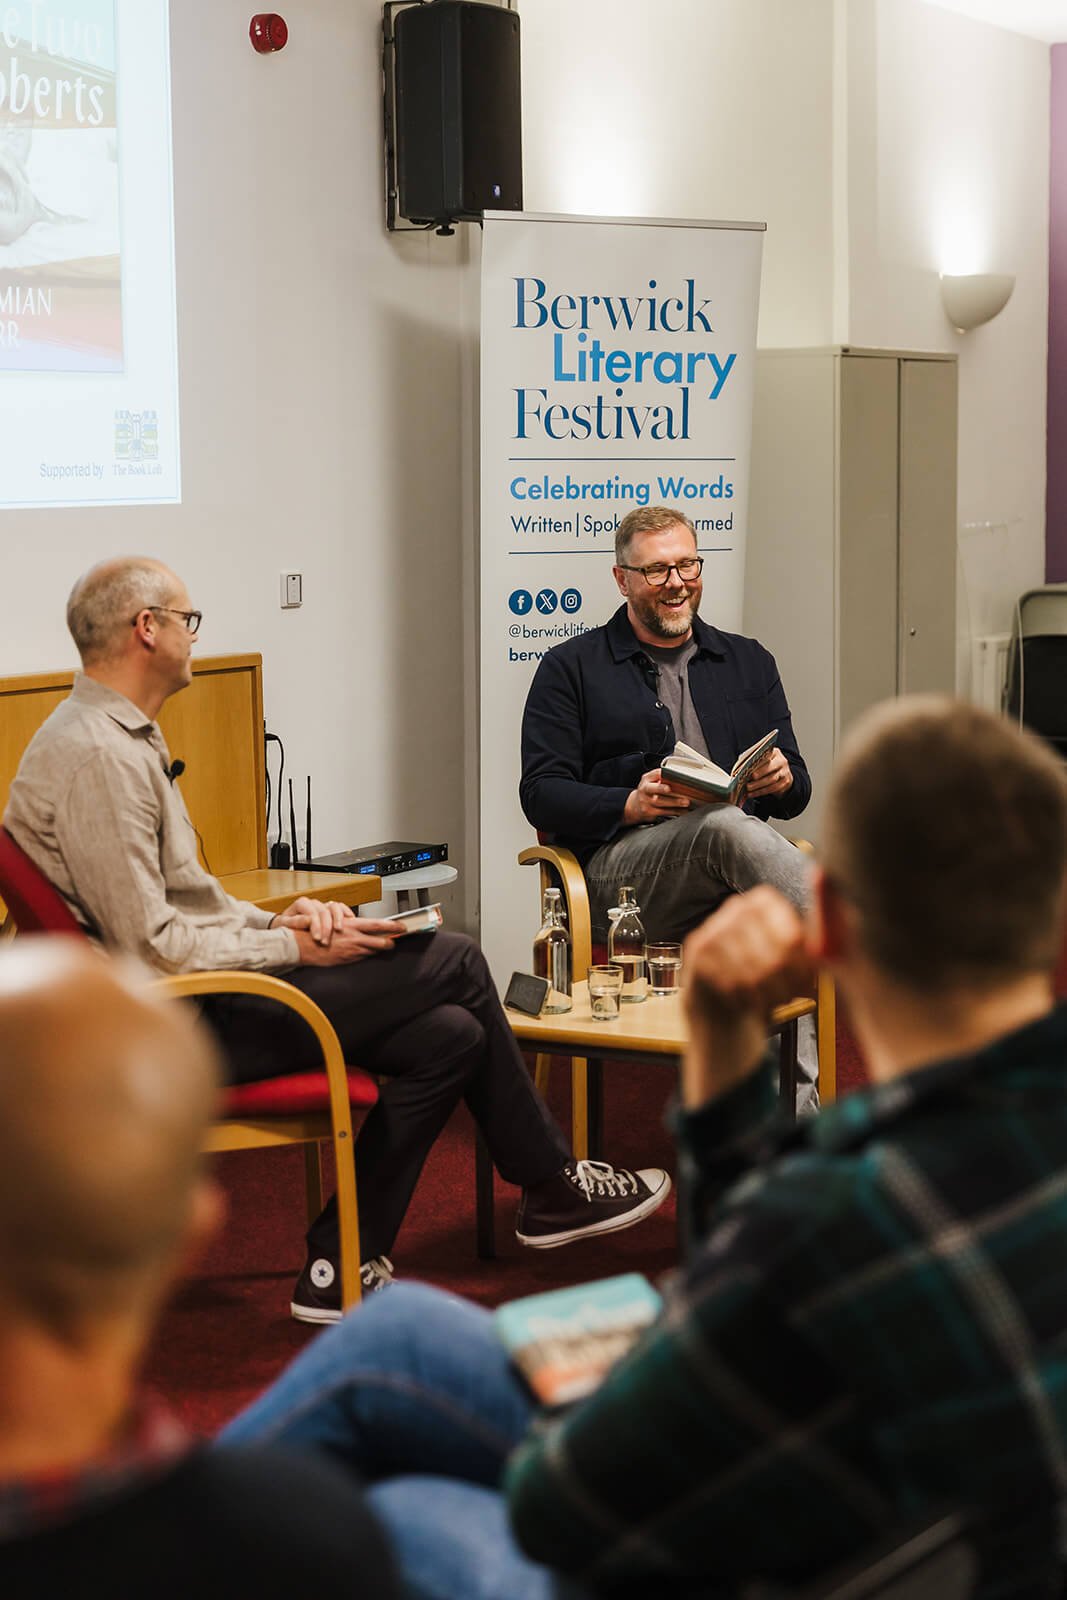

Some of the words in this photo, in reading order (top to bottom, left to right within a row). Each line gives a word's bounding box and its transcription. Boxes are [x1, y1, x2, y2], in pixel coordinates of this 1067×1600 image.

[511, 277, 714, 332] Berwick
[553, 332, 737, 400] Literary
[511, 387, 691, 440] Festival
[40, 463, 91, 479] Supported
[92, 463, 104, 480] by
[510, 475, 650, 506] Celebrating
[657, 475, 734, 499] Words
[583, 513, 621, 537] Spok
[688, 512, 733, 530] rmed
[509, 646, 551, 662] berw
